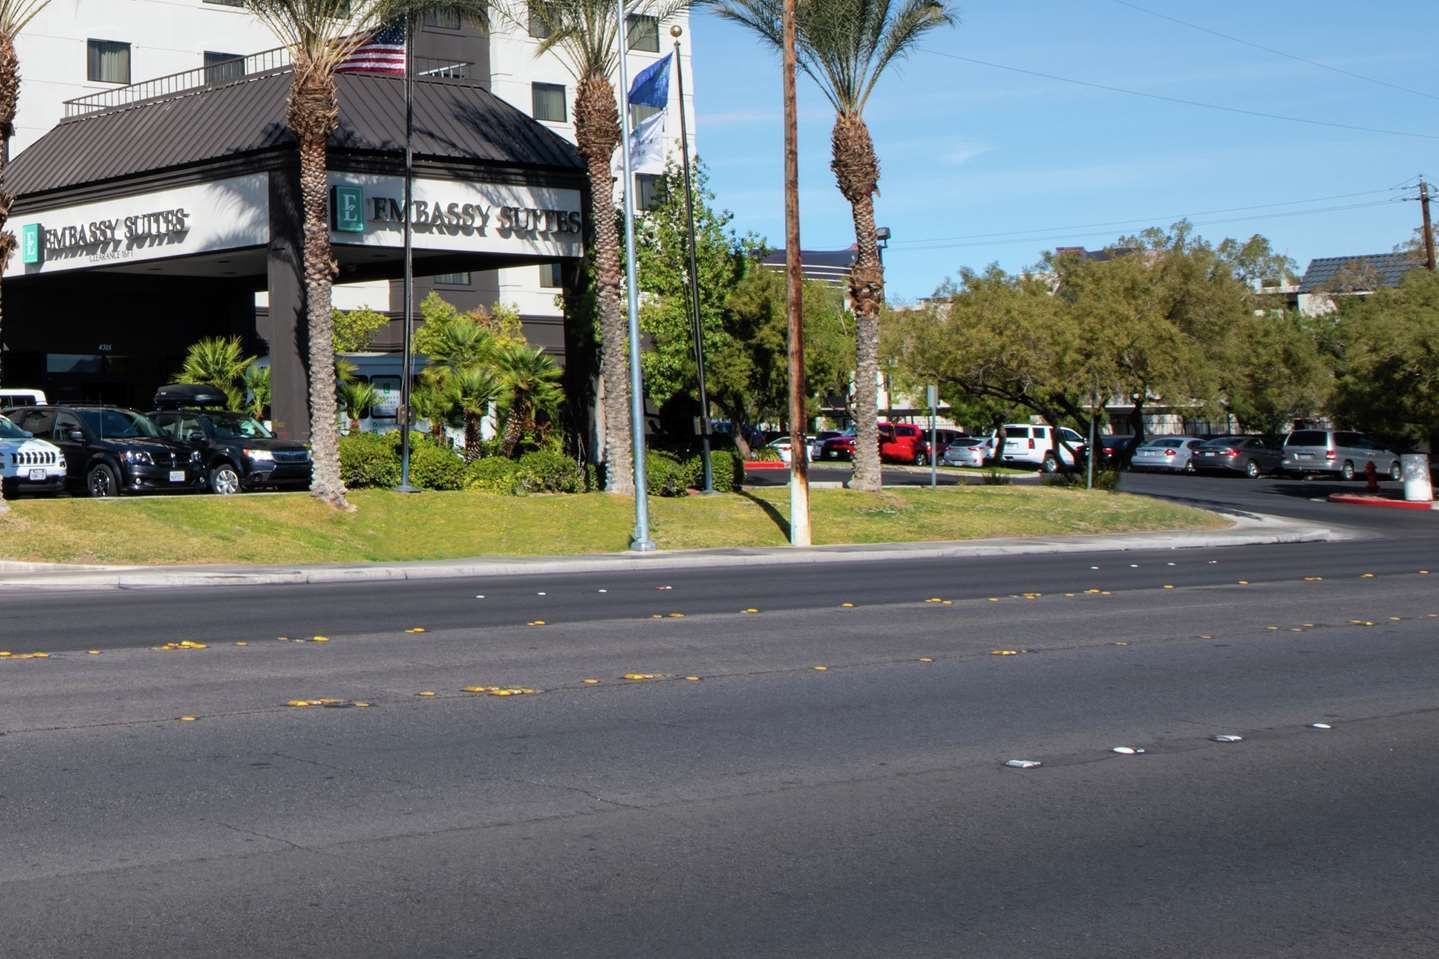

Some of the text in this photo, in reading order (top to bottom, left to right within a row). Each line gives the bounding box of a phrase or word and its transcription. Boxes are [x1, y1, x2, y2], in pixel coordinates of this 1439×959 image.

[45, 208, 187, 249] EMBASSY SUITES
[372, 197, 581, 234] EMBASSY SUITES
